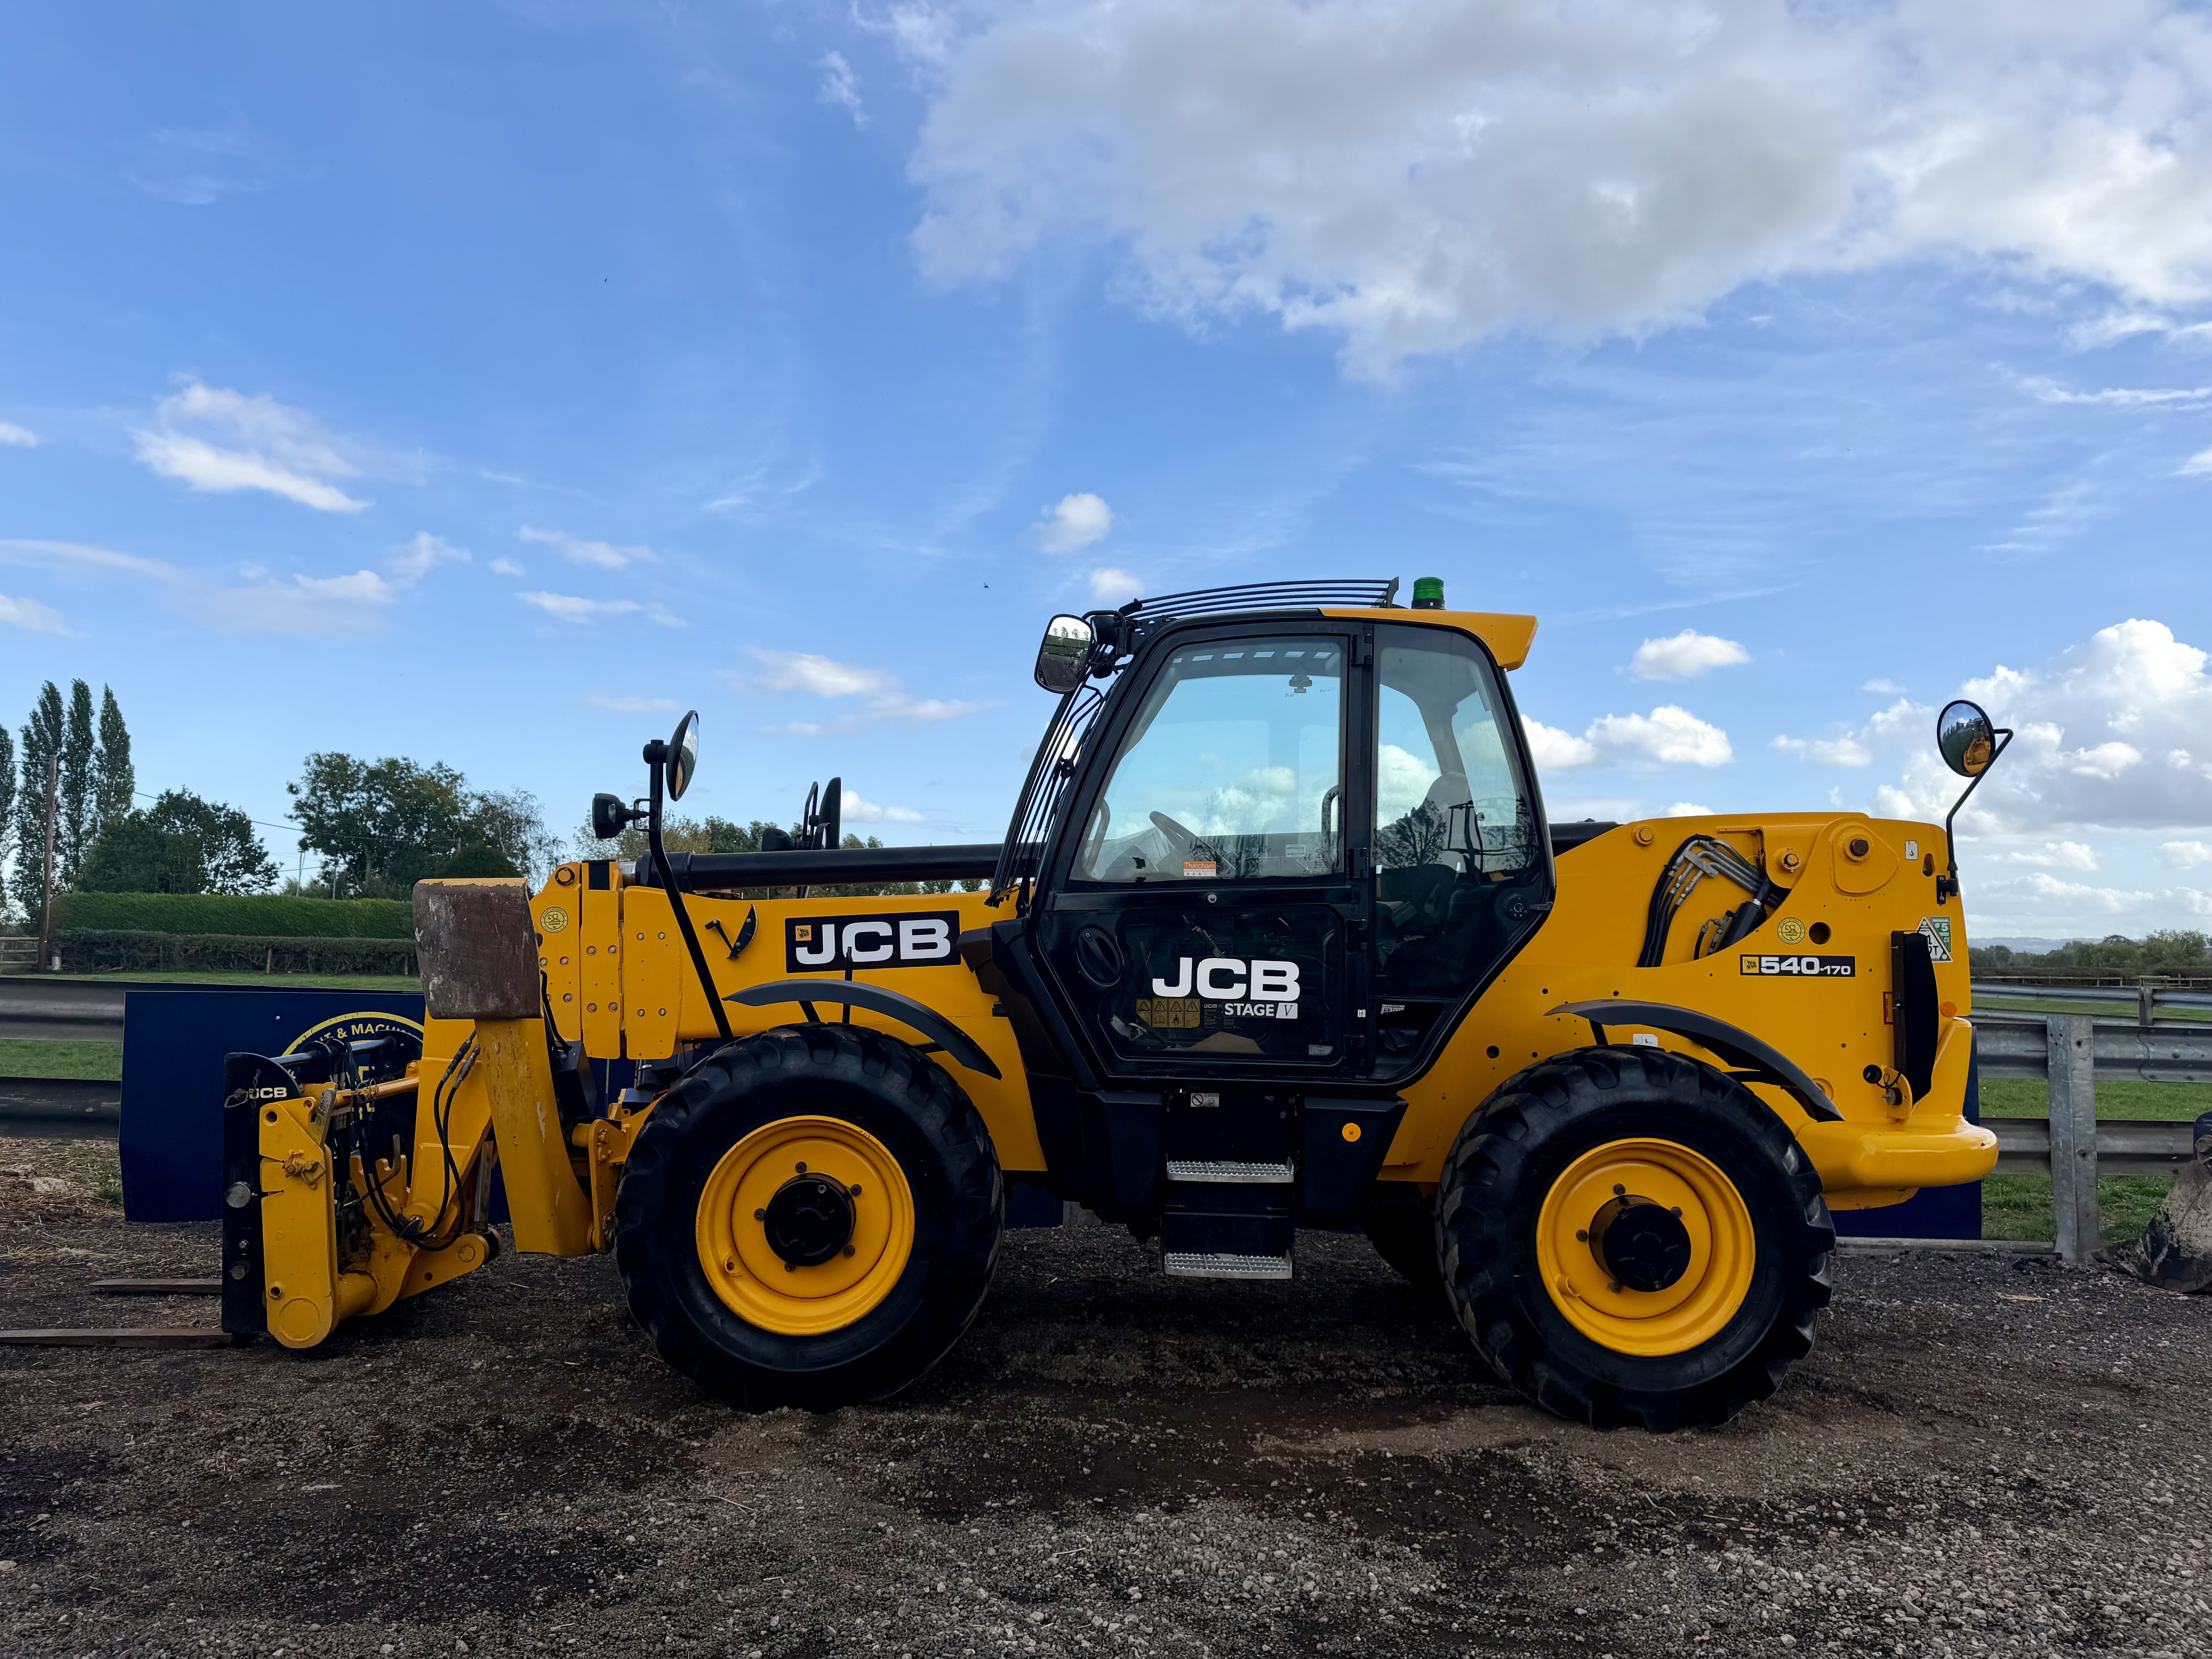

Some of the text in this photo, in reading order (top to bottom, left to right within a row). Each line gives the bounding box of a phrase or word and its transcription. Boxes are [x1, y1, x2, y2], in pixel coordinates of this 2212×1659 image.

[1941, 922, 1948, 932] 5
[795, 919, 951, 965] JCB
[1152, 957, 1300, 1001] JCB
[1224, 1003, 1293, 1017] STAGE V
[337, 1028, 348, 1039] &
[249, 1087, 287, 1099] JCB
